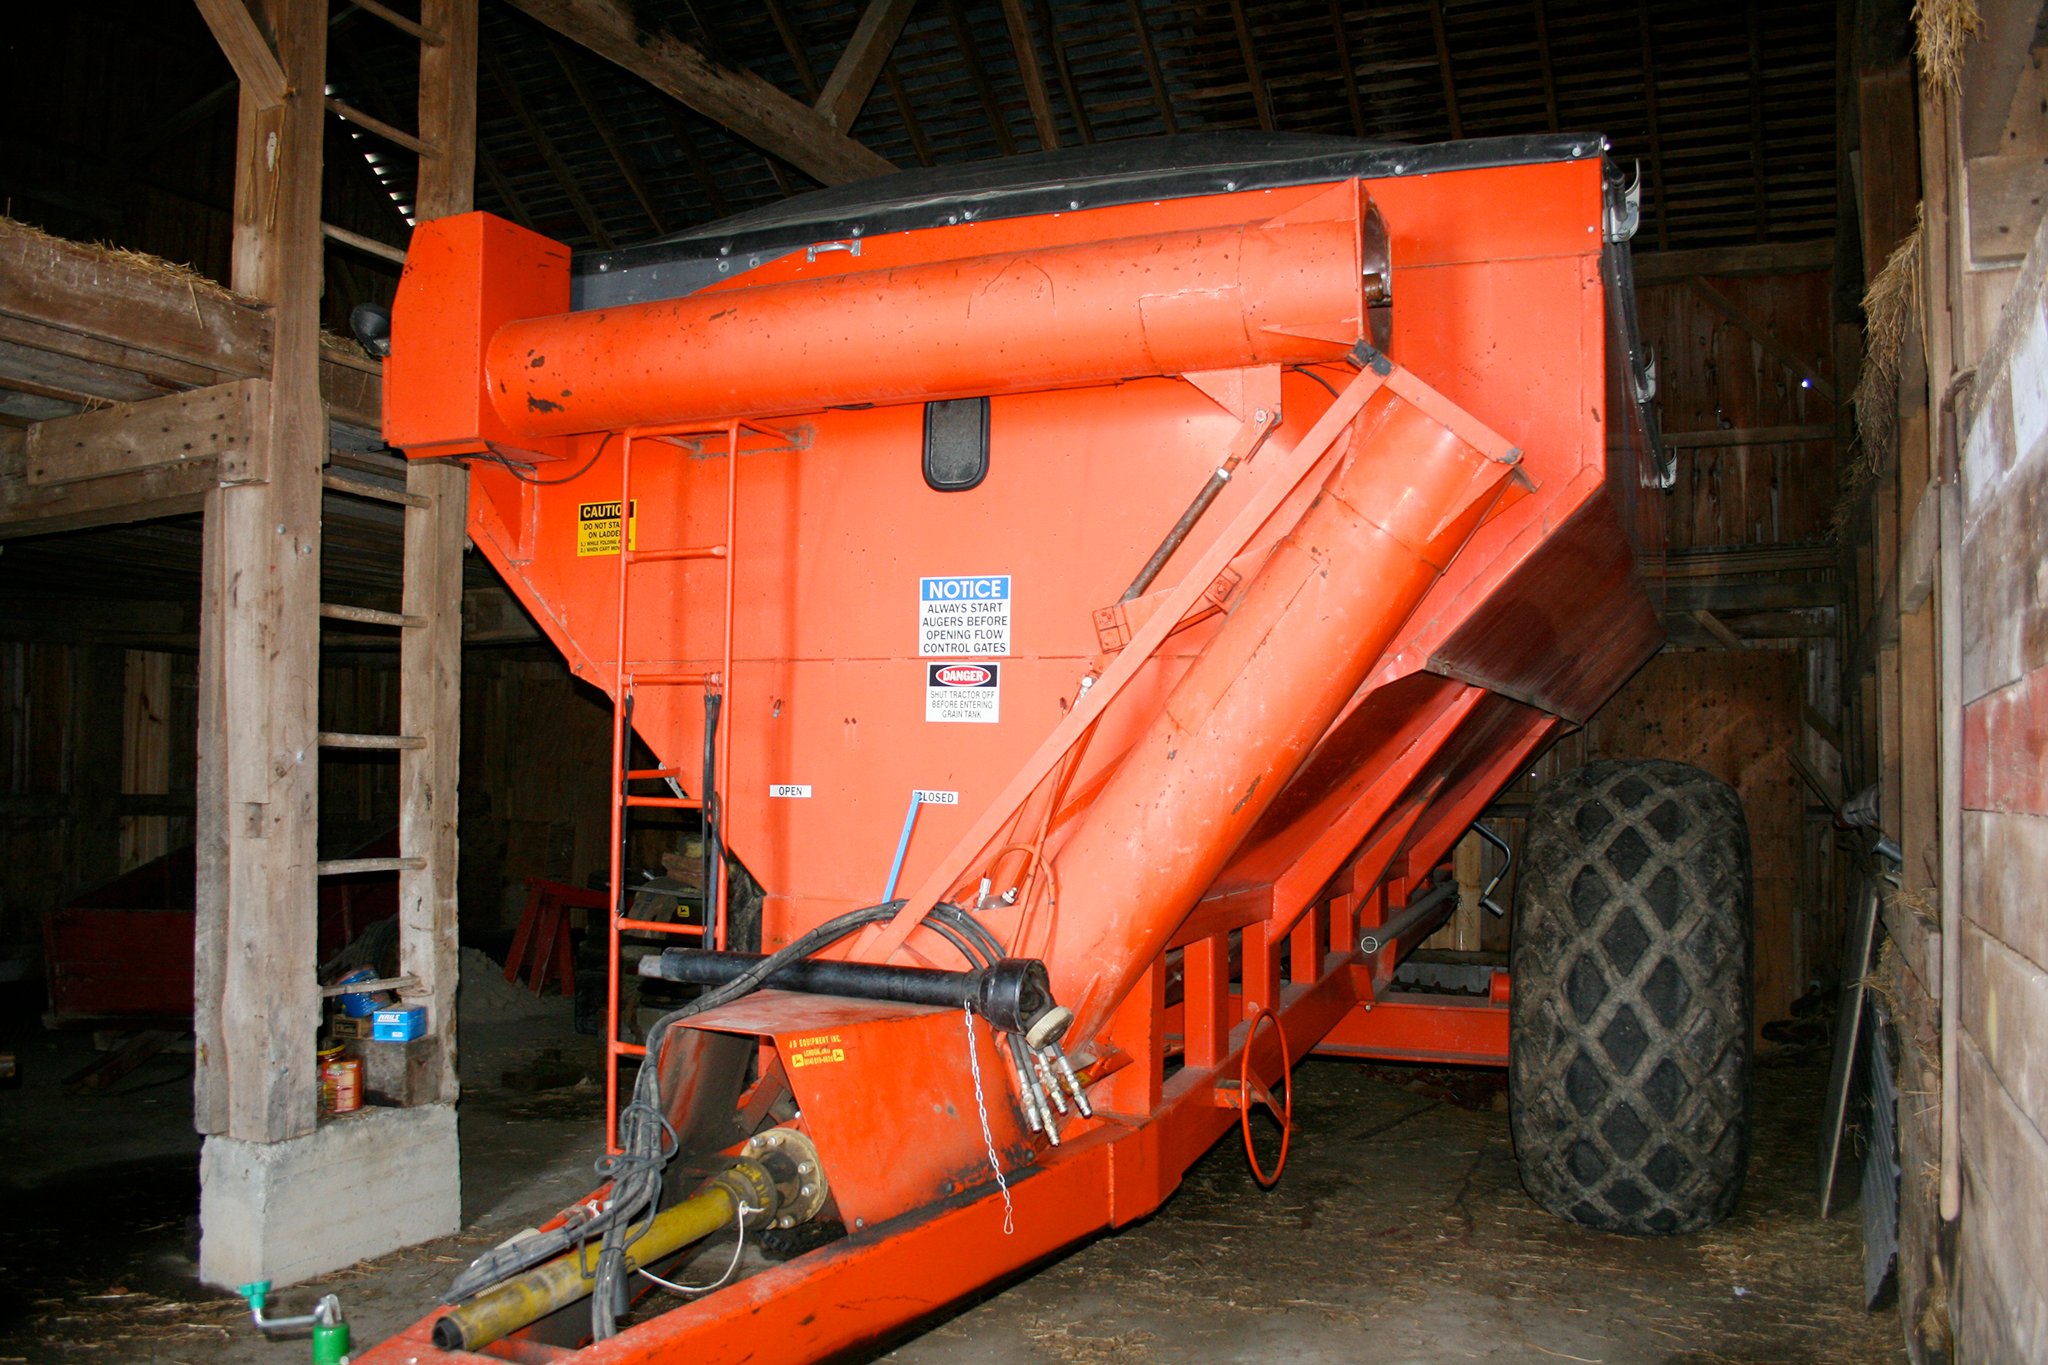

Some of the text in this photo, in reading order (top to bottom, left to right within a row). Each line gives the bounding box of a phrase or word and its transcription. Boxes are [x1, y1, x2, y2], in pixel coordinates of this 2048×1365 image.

[583, 504, 622, 518] CAUTIO
[608, 521, 620, 529] STA
[599, 530, 620, 538] LADDE
[929, 580, 1001, 599] NOTICE
[927, 602, 1002, 613] ALWAYS START
[922, 615, 1007, 627] AUGERS BEFORE
[926, 629, 1003, 640] OPENING FLOW
[923, 642, 1006, 653] CONTROL GATES
[943, 670, 984, 682] DANGER
[930, 690, 995, 699] SHUT TRACTOR OFF
[931, 700, 993, 709] BEFORE ENTERING
[942, 710, 981, 719] GRAIN TANK
[778, 786, 803, 796] OPEN
[799, 1036, 829, 1046] EQUIPMENT
